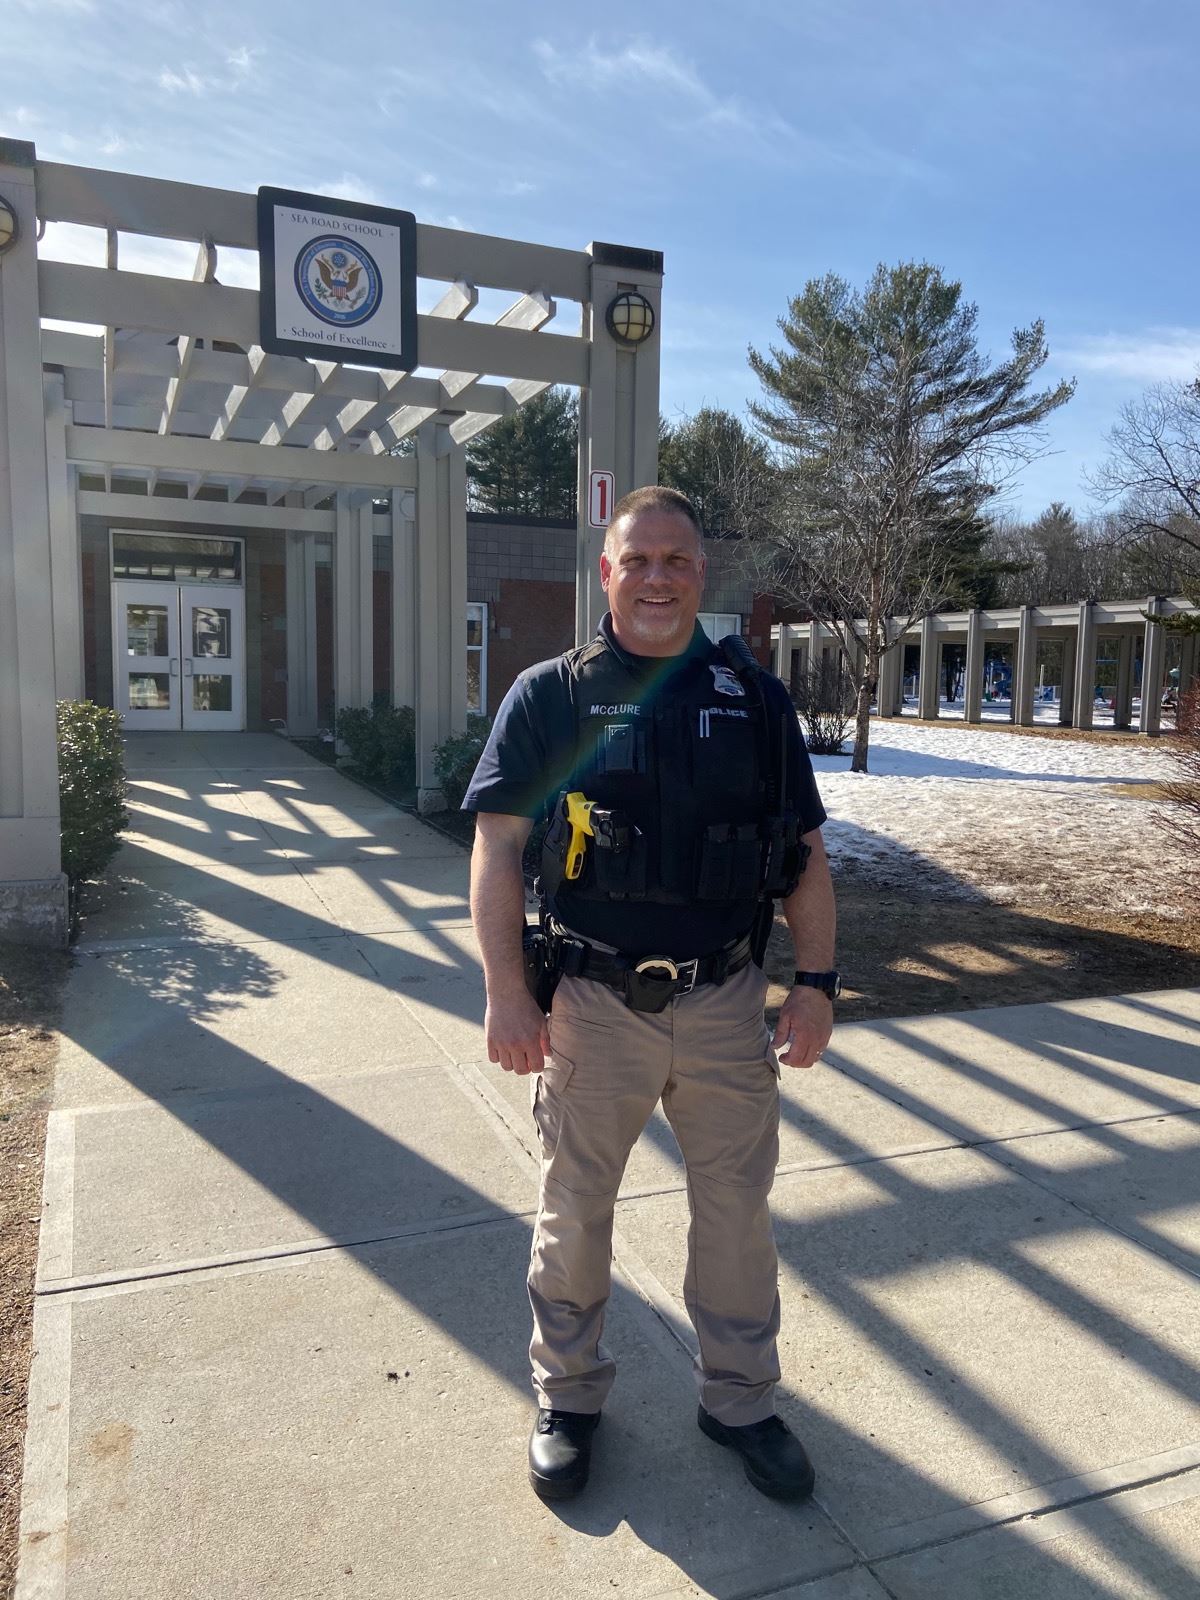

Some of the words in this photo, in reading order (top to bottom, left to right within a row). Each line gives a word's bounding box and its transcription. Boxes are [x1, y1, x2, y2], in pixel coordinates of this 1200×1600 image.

[291, 213, 309, 225] SEA
[311, 217, 340, 230] ROAD
[342, 222, 383, 237] SCHOOL
[291, 326, 324, 340] School
[326, 332, 337, 342] of
[339, 333, 388, 349] Excellence
[597, 479, 607, 520] 1
[590, 704, 641, 715] MCCLURE
[702, 707, 749, 718] OLICE
